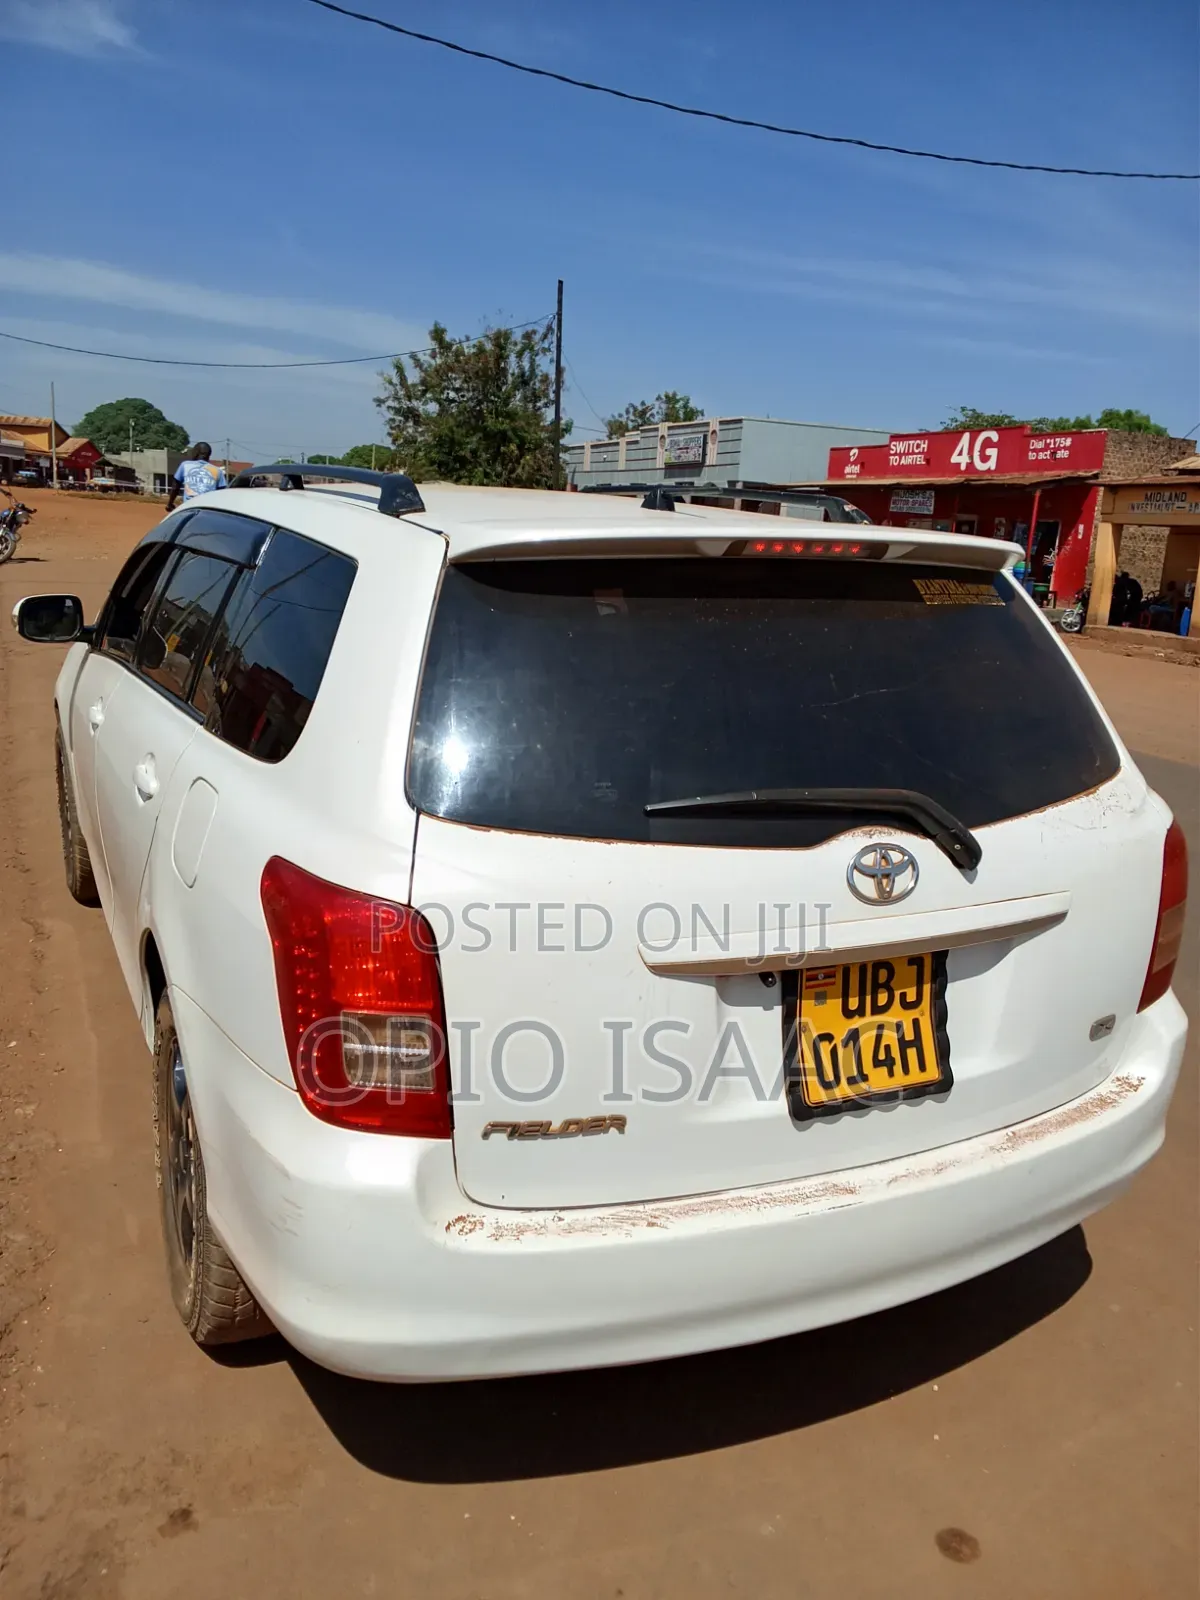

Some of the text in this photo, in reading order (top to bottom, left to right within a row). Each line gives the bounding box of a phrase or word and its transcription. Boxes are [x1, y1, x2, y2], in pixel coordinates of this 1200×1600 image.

[890, 440, 928, 454] SWITCH
[1030, 439, 1045, 449] Dial
[950, 430, 999, 471] 4G
[1028, 449, 1069, 460] to actate
[889, 455, 926, 466] TO AIRTEL
[844, 464, 860, 474] airtel
[1144, 491, 1187, 502] MIDLAND
[841, 956, 925, 1019] UBJ
[813, 1017, 927, 1090] 014H
[481, 1114, 627, 1141] FIELDER
